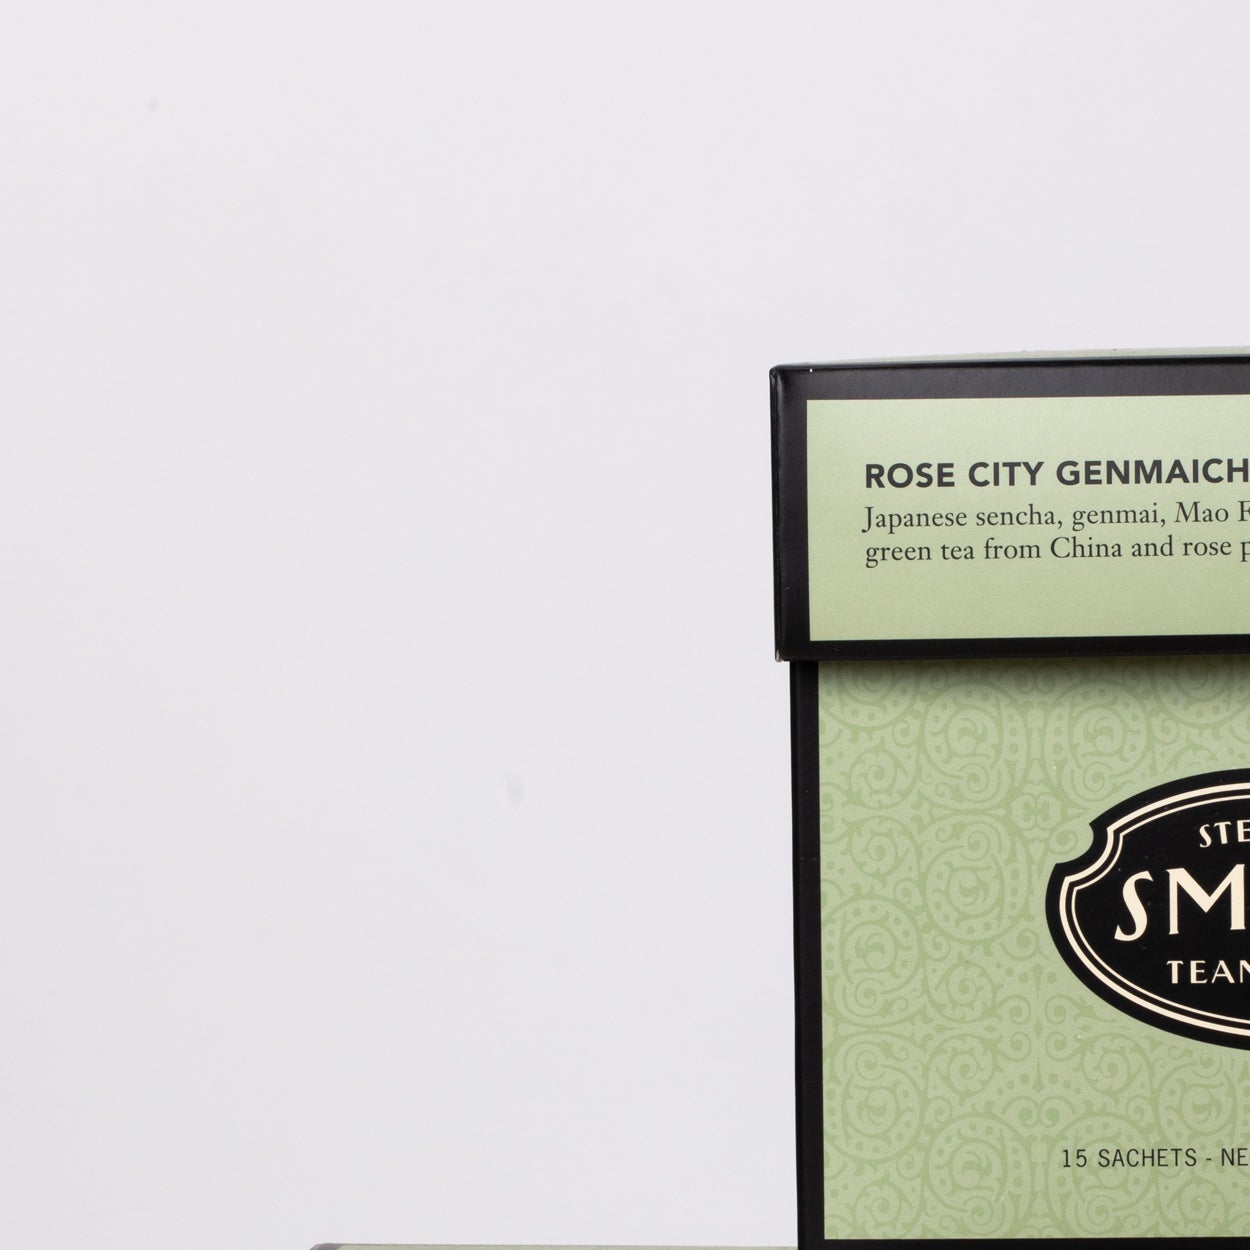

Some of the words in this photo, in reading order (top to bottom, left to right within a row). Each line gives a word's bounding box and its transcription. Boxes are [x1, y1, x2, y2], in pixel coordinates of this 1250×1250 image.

[865, 462, 955, 489] ROSE
[968, 461, 1045, 488] CITY
[861, 506, 968, 535] Japanese
[975, 503, 1063, 530] sencha,
[1071, 505, 1166, 532] genmai,
[1174, 501, 1229, 523] Mao
[865, 546, 932, 569] green
[940, 544, 975, 561] tea
[983, 537, 1042, 560] from
[1050, 535, 1123, 559] China
[1131, 534, 1174, 558] and
[1183, 541, 1232, 556] rose
[1062, 1148, 1088, 1168] 15
[1097, 1147, 1197, 1168] SACHETS
